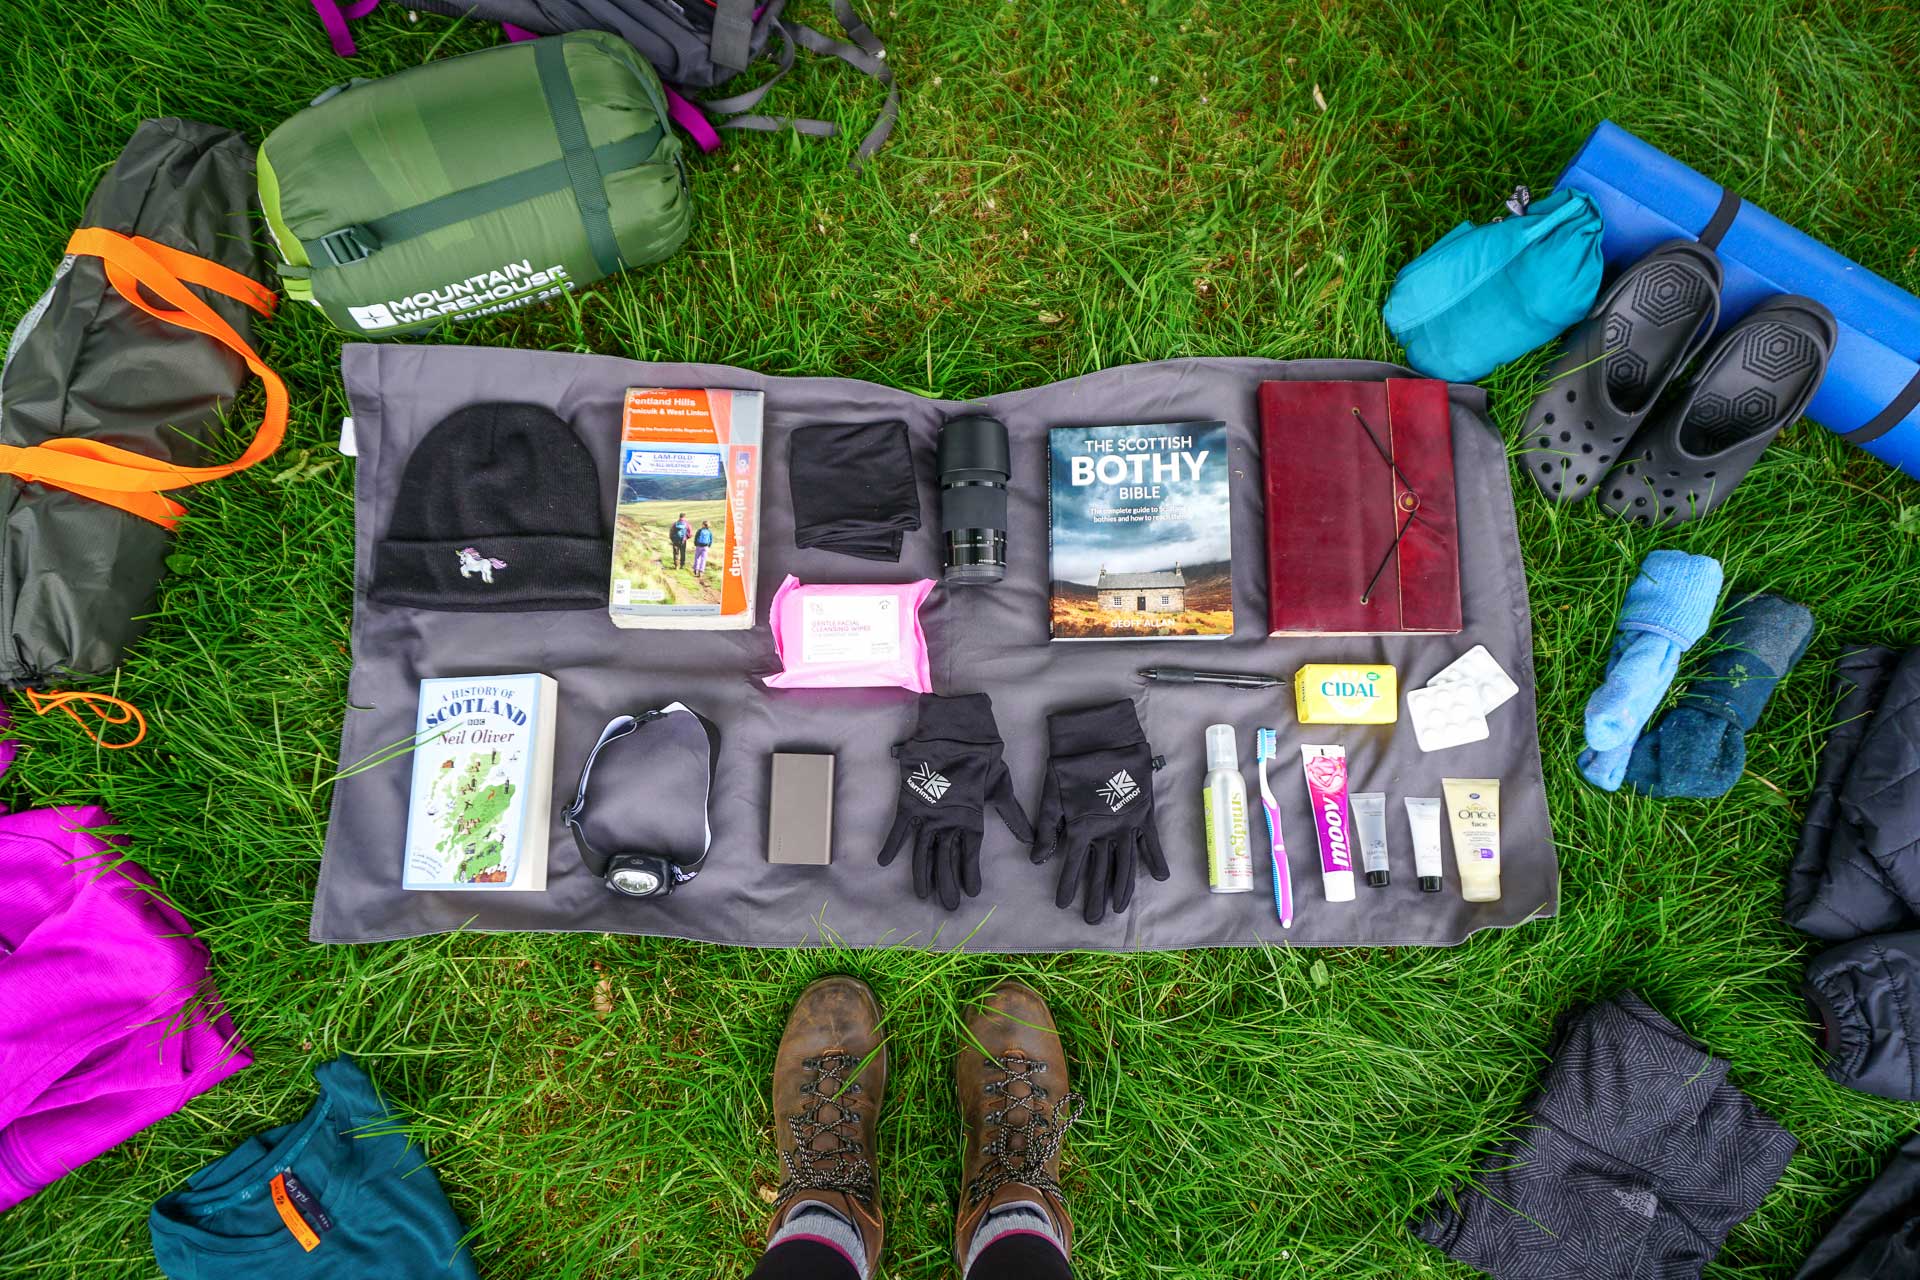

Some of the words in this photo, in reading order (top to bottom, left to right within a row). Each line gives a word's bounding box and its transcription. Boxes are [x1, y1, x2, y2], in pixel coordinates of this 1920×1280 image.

[388, 259, 533, 313] MOUNTAIN
[396, 264, 569, 323] WAREHOUSE
[454, 295, 534, 321] SUMMIT
[538, 281, 576, 300] 250
[629, 396, 672, 406] Pentland
[673, 398, 697, 406] Hills
[666, 408, 685, 416] West
[1085, 440, 1114, 452] THE
[1118, 436, 1193, 451] SCOTTISH
[1071, 450, 1209, 487] BOTHY
[1119, 486, 1161, 500] BIBLE
[733, 479, 749, 540] Explorer
[1133, 507, 1150, 515] guide
[1094, 515, 1117, 523] bothies
[729, 545, 745, 577] Map
[1110, 620, 1140, 628] GEOFF
[1143, 618, 1175, 627] ALLAN
[452, 686, 499, 699] HISTORY
[501, 688, 514, 699] OF
[1321, 681, 1380, 698] CIDAL
[426, 698, 527, 729] SCOTLAND
[437, 729, 466, 744] Neil
[471, 729, 515, 744] Oliver
[906, 776, 937, 804] karrimor
[1111, 787, 1141, 812] karrimor
[1458, 810, 1496, 820] Once
